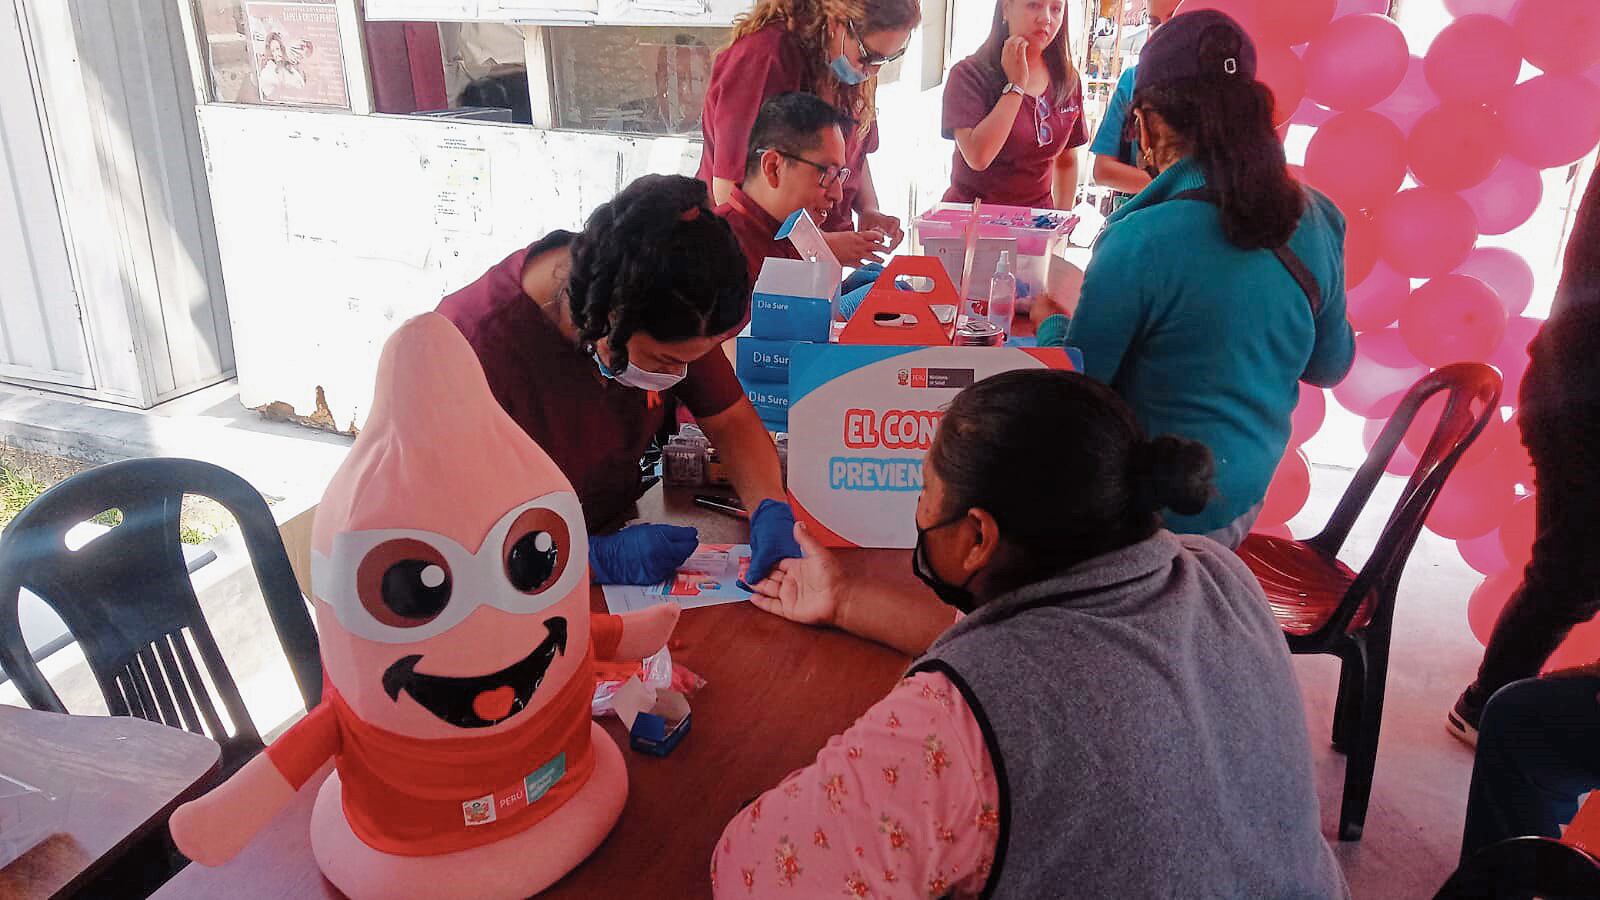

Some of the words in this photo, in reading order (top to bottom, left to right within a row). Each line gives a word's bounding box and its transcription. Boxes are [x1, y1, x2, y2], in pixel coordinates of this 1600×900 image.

[772, 302, 788, 310] Sure
[773, 354, 789, 365] Sur
[767, 395, 789, 406] Sure
[845, 412, 877, 446] EL
[882, 412, 939, 447] CON
[831, 460, 924, 489] PREVIEN
